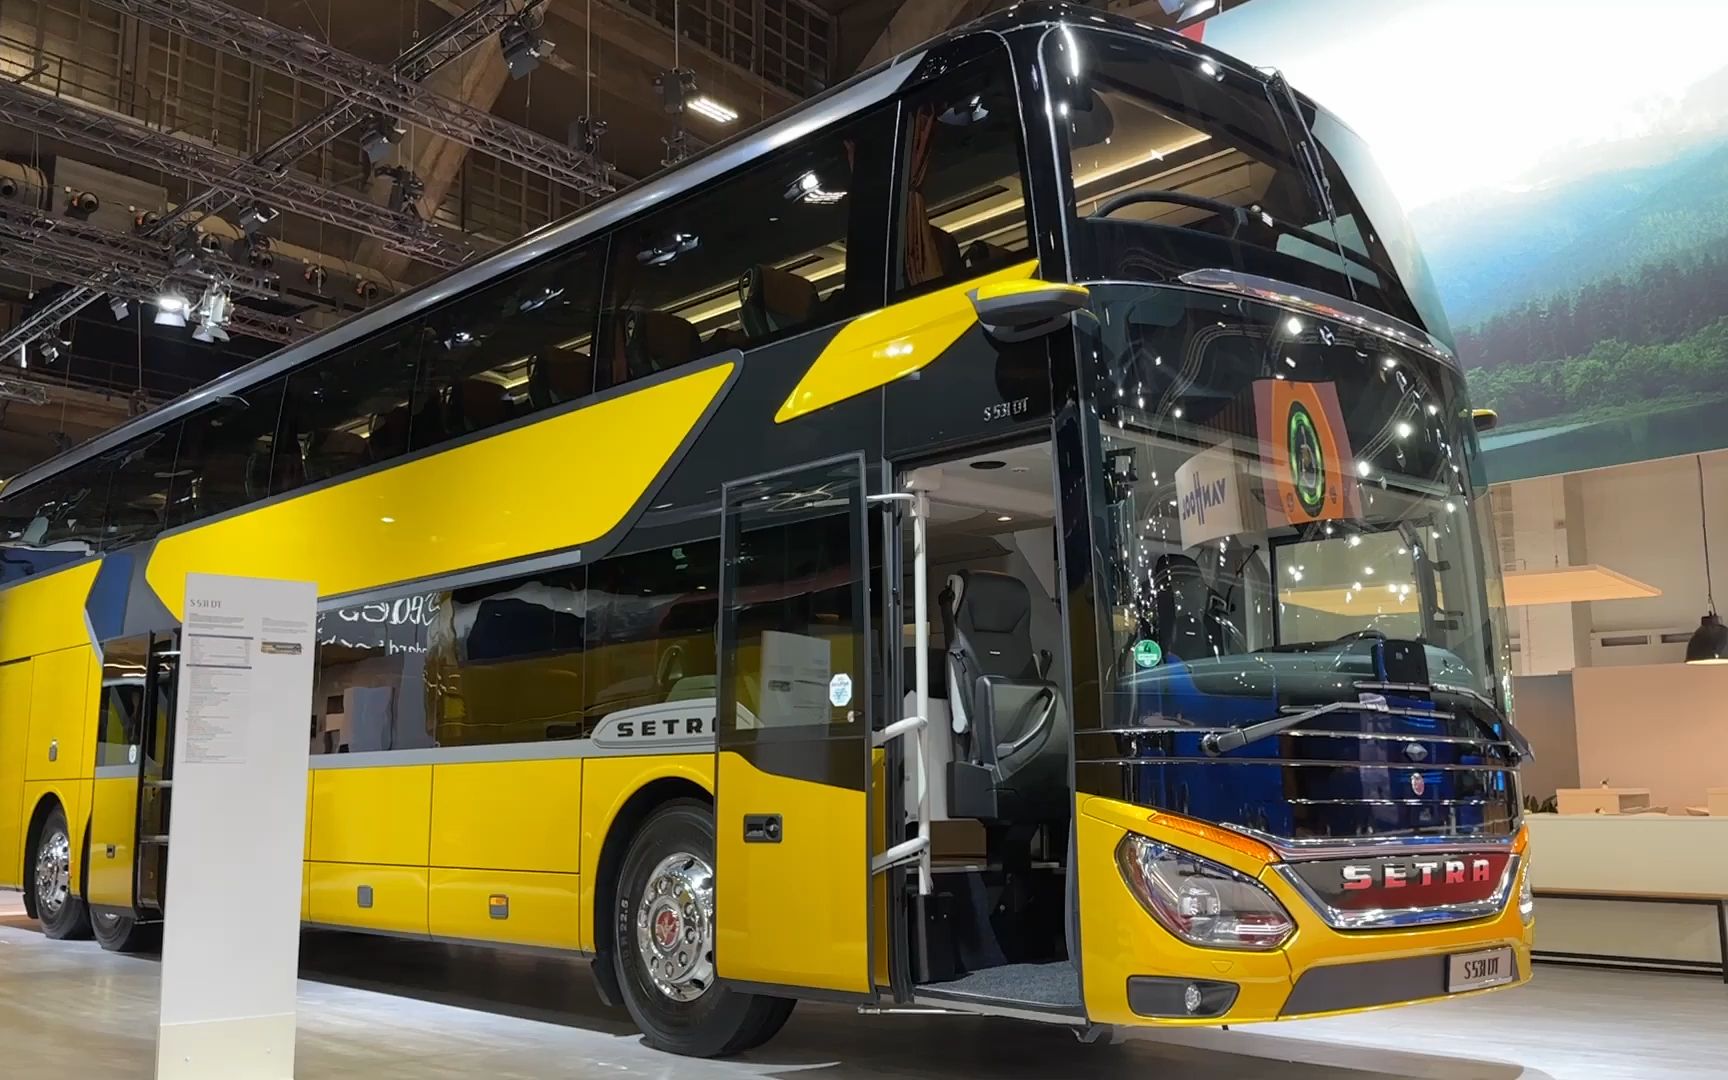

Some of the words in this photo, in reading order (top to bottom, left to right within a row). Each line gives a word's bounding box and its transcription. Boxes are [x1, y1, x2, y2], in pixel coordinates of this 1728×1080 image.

[983, 406, 991, 421] S
[993, 401, 1010, 419] 531
[1013, 397, 1029, 415] DT
[1341, 858, 1490, 890] SETRA
[1464, 961, 1472, 980] S
[1472, 959, 1486, 979] 531
[1487, 957, 1500, 976] DT
